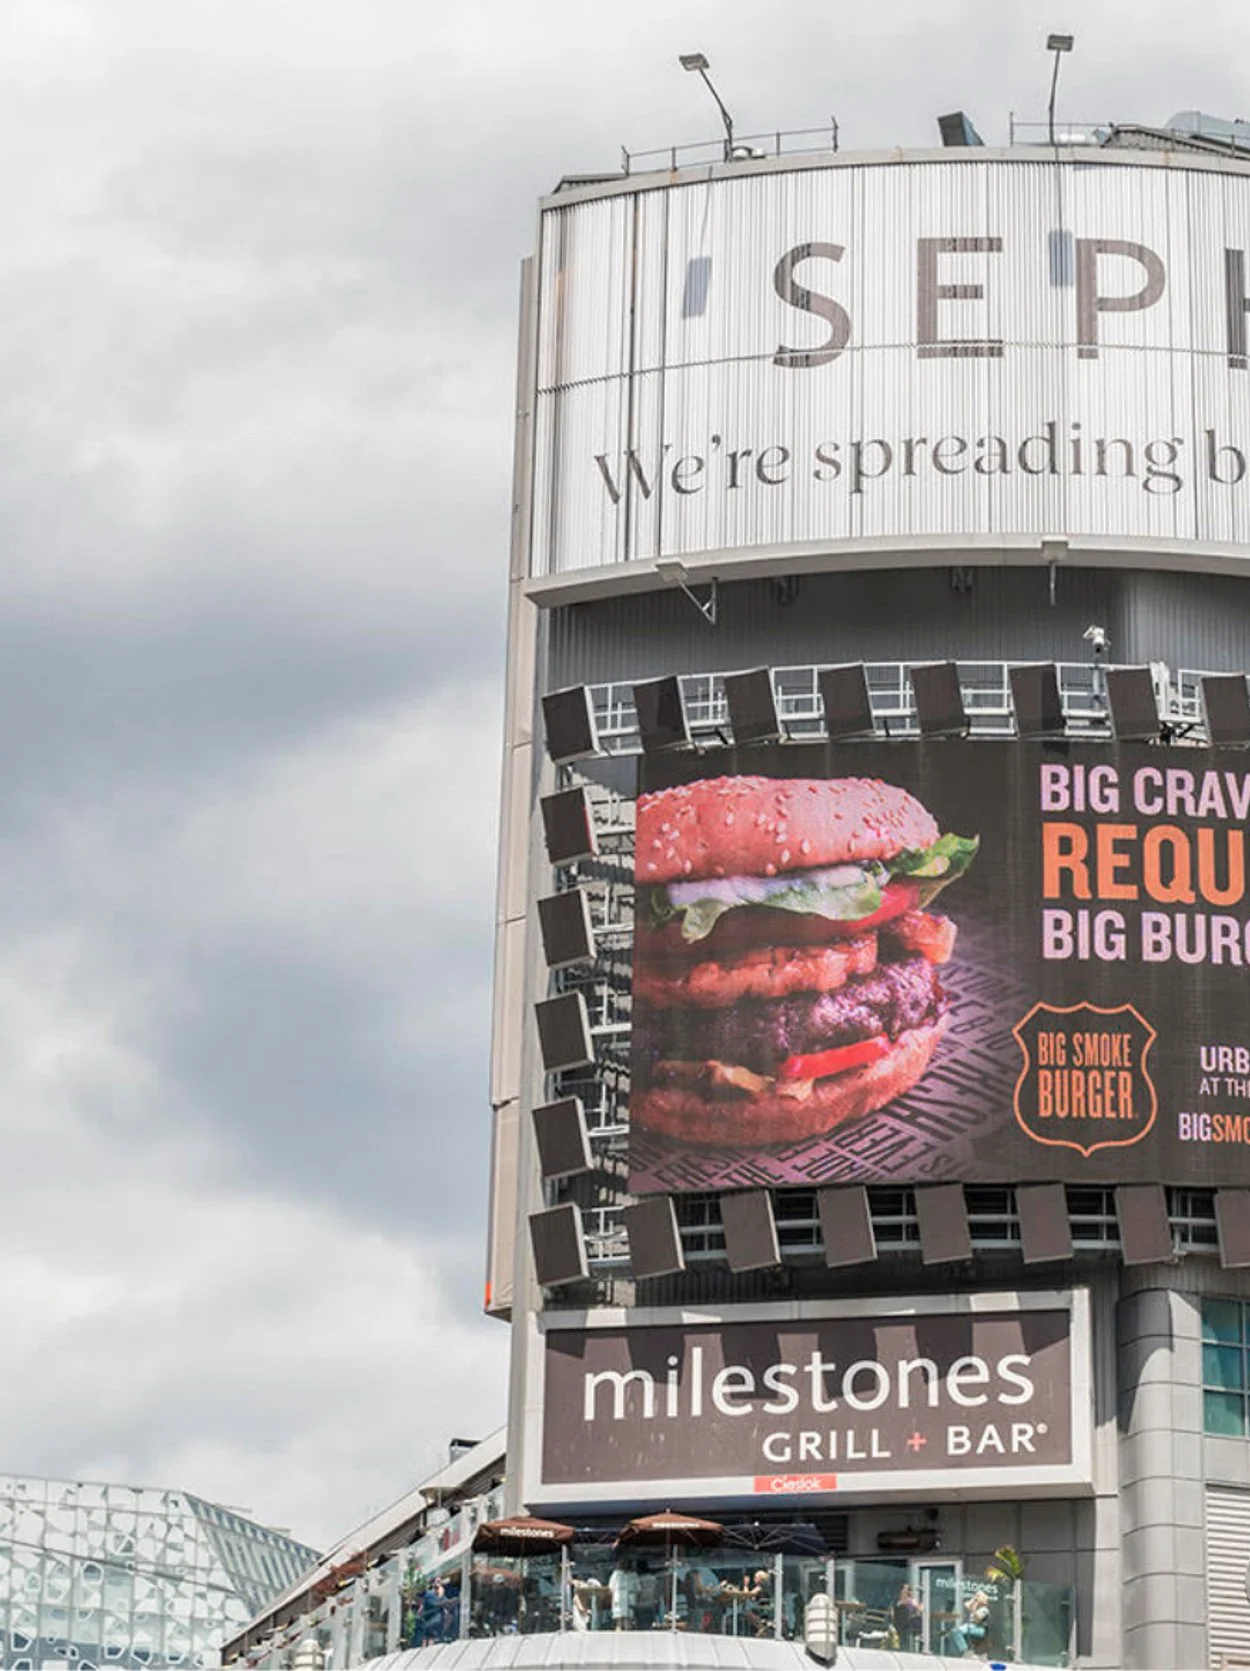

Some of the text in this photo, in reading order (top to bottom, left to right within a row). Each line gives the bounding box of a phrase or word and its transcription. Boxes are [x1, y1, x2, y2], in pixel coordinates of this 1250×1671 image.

[813, 422, 1184, 495] spreading
[1040, 764, 1119, 814] BIG
[1042, 909, 1126, 960] BIG
[1038, 1032, 1132, 1067] BIG SMOKE
[1038, 1069, 1133, 1118] BURGER
[1200, 1077, 1219, 1096] AT
[584, 1347, 1035, 1420] milestones
[762, 1429, 892, 1463] GRILL
